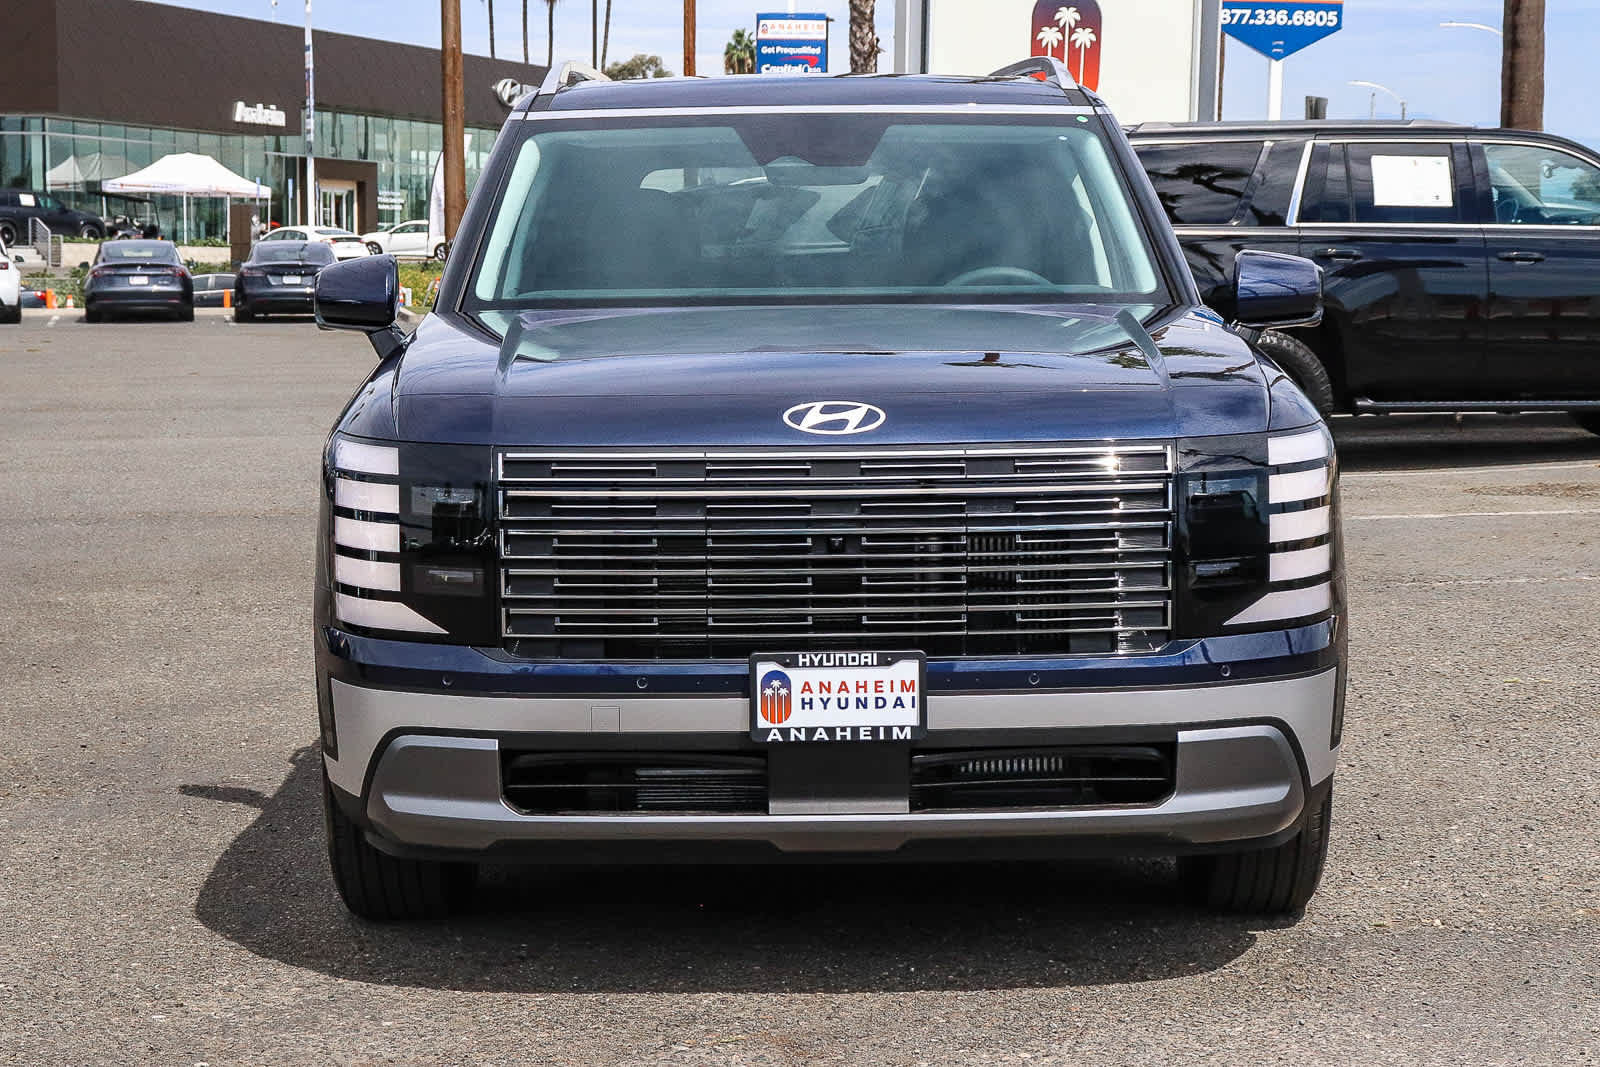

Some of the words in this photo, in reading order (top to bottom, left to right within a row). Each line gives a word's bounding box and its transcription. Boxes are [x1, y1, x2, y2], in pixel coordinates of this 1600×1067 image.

[1221, 8, 1338, 27] 877.336.6805
[761, 46, 775, 54] Get
[776, 46, 821, 55] Prequalified
[798, 652, 878, 667] HYUNDAI
[800, 679, 916, 695] ANAHEIM
[800, 695, 916, 711] HYUNDAI
[766, 726, 913, 742] ANAHEIM
